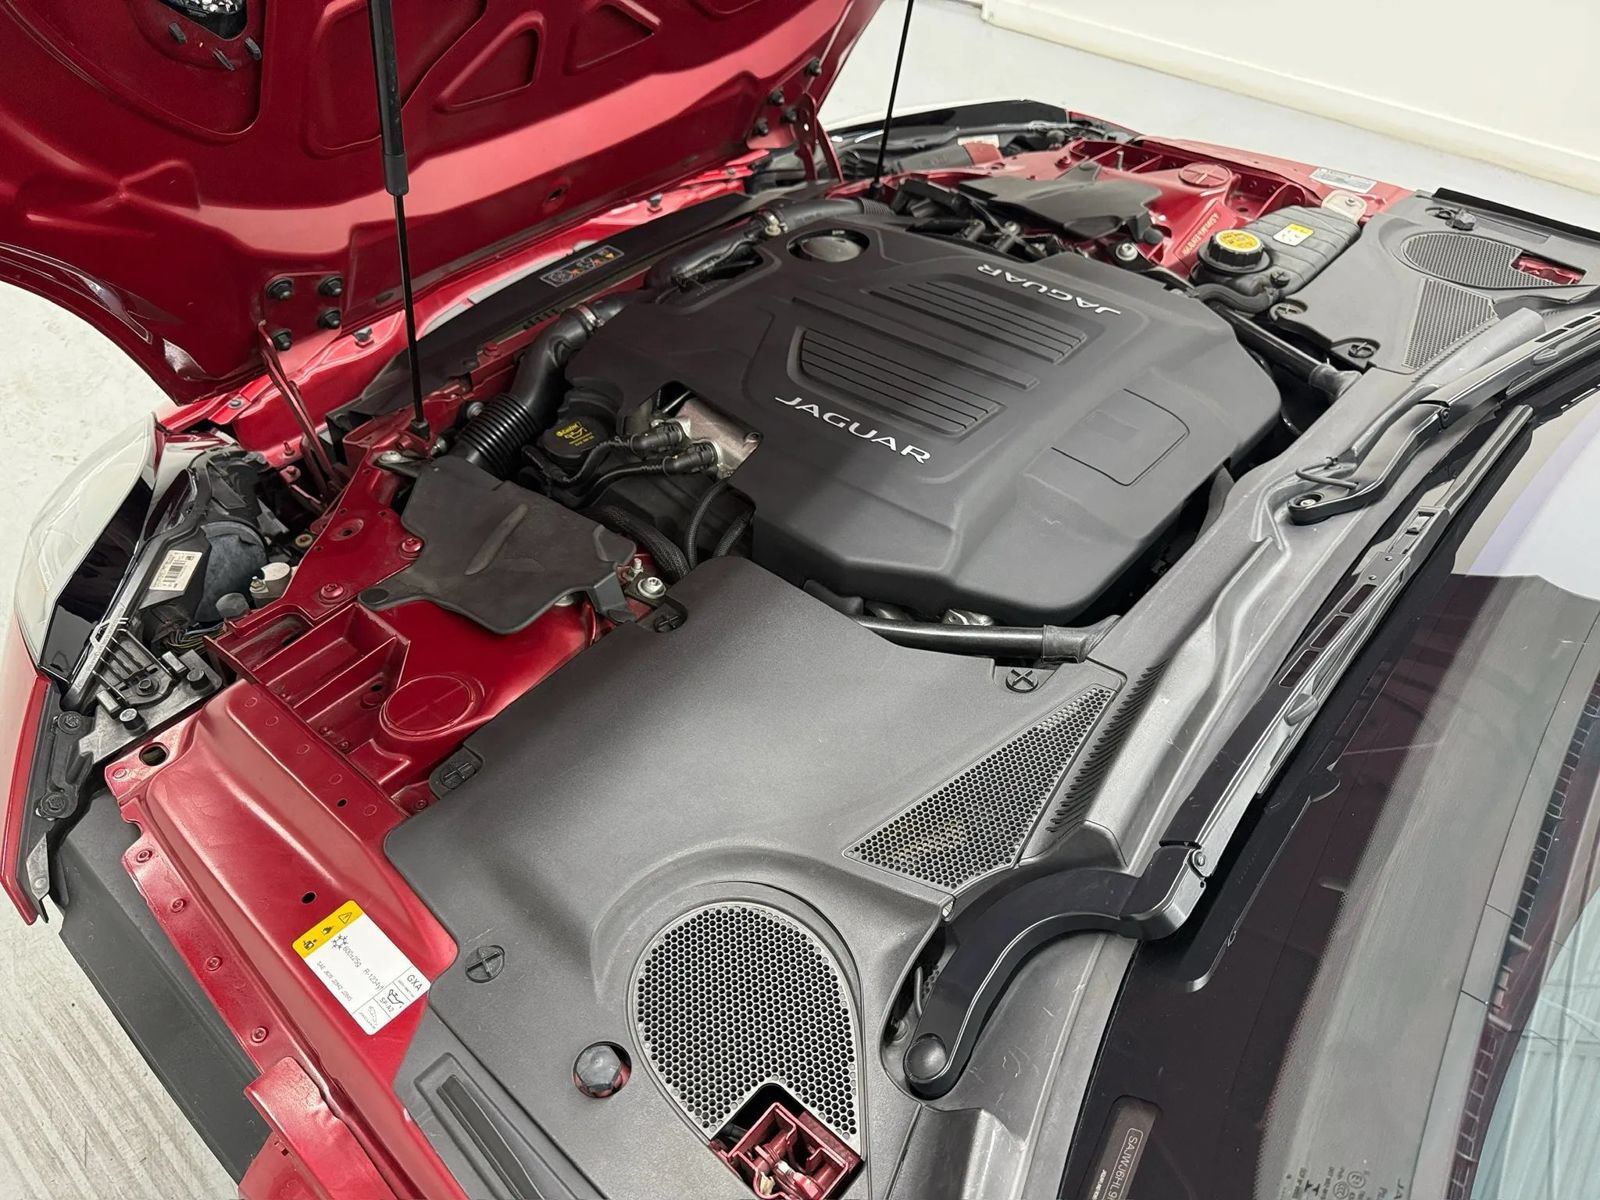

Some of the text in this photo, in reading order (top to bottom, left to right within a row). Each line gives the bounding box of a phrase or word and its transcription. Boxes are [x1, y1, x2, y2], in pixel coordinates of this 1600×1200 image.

[977, 264, 1121, 315] JAGUAR
[774, 396, 931, 464] JAGUAR
[406, 974, 423, 991] GXA
[1107, 1135, 1138, 1200] SAJWJ6HL9
